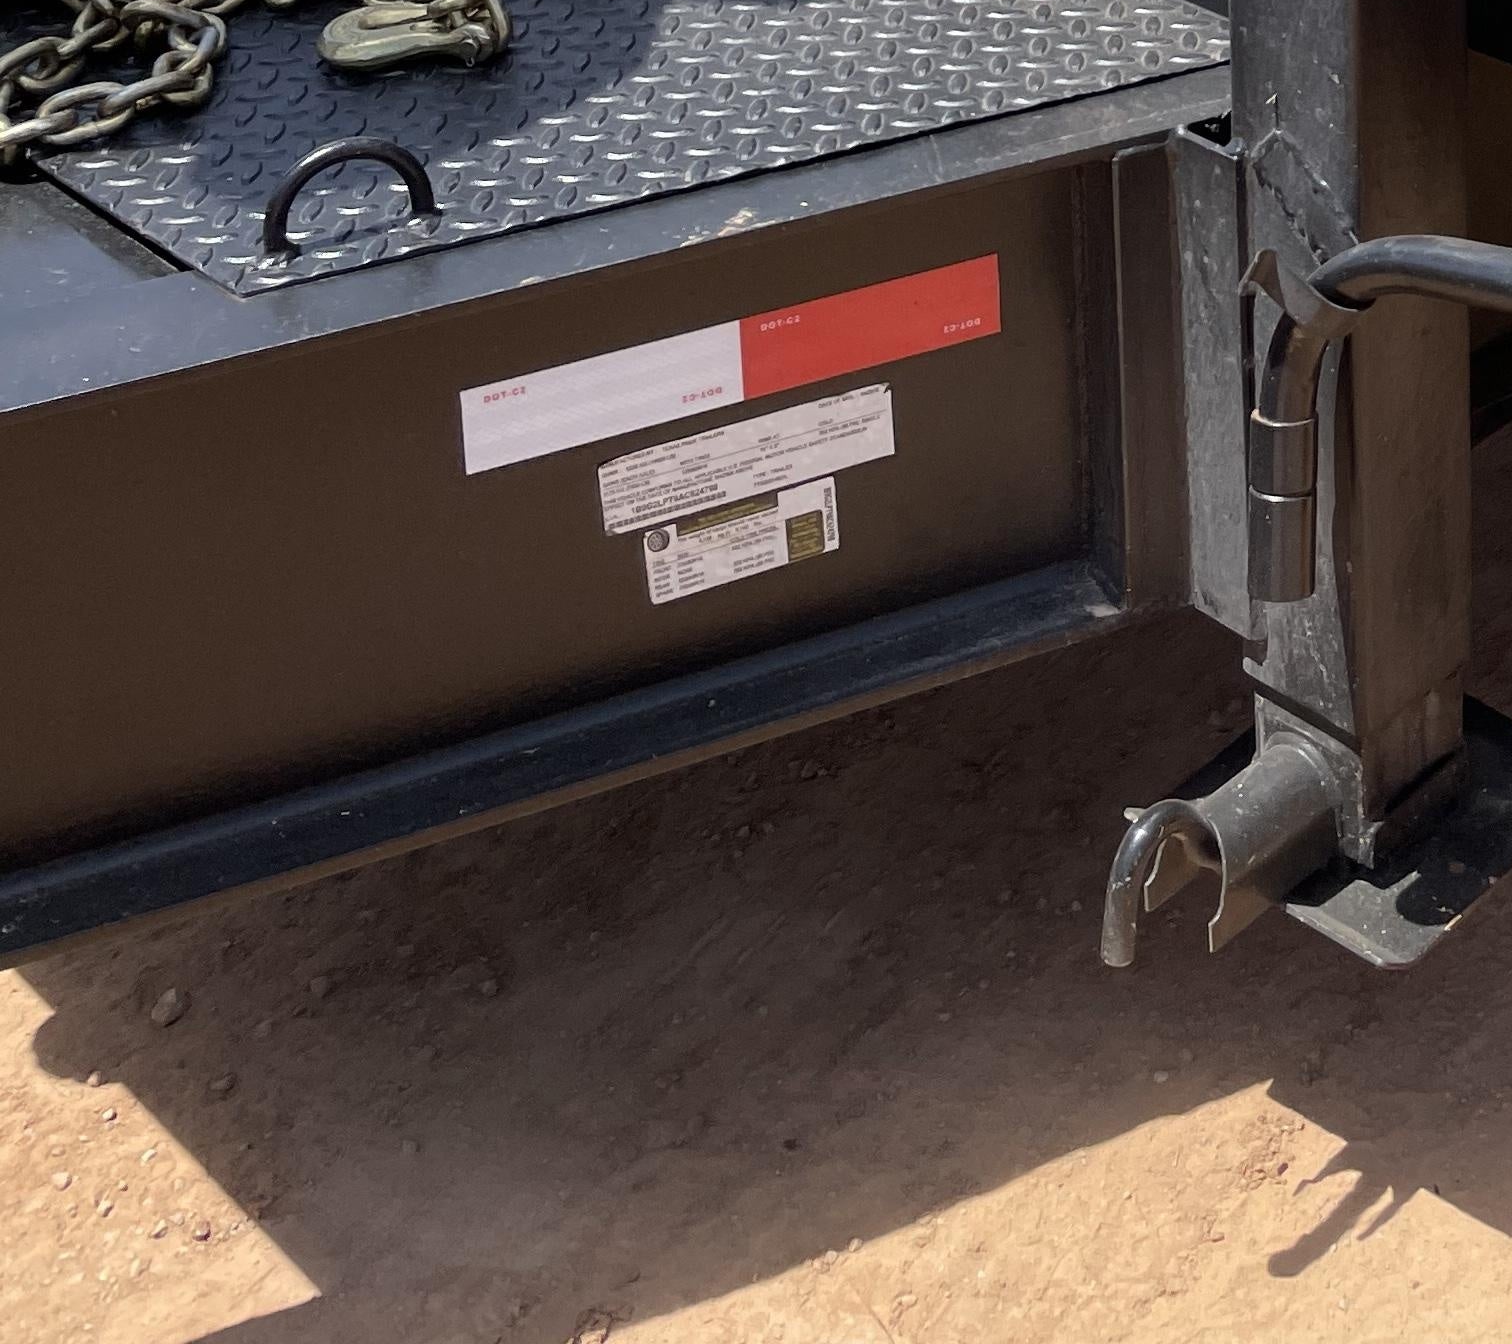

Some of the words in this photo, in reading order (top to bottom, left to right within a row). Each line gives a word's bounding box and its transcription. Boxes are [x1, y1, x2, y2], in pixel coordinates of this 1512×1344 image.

[759, 314, 801, 332] DOT-C2
[942, 316, 982, 334] DOT-C2
[482, 385, 527, 404] DOT-C2
[681, 385, 724, 404] DOT-C2
